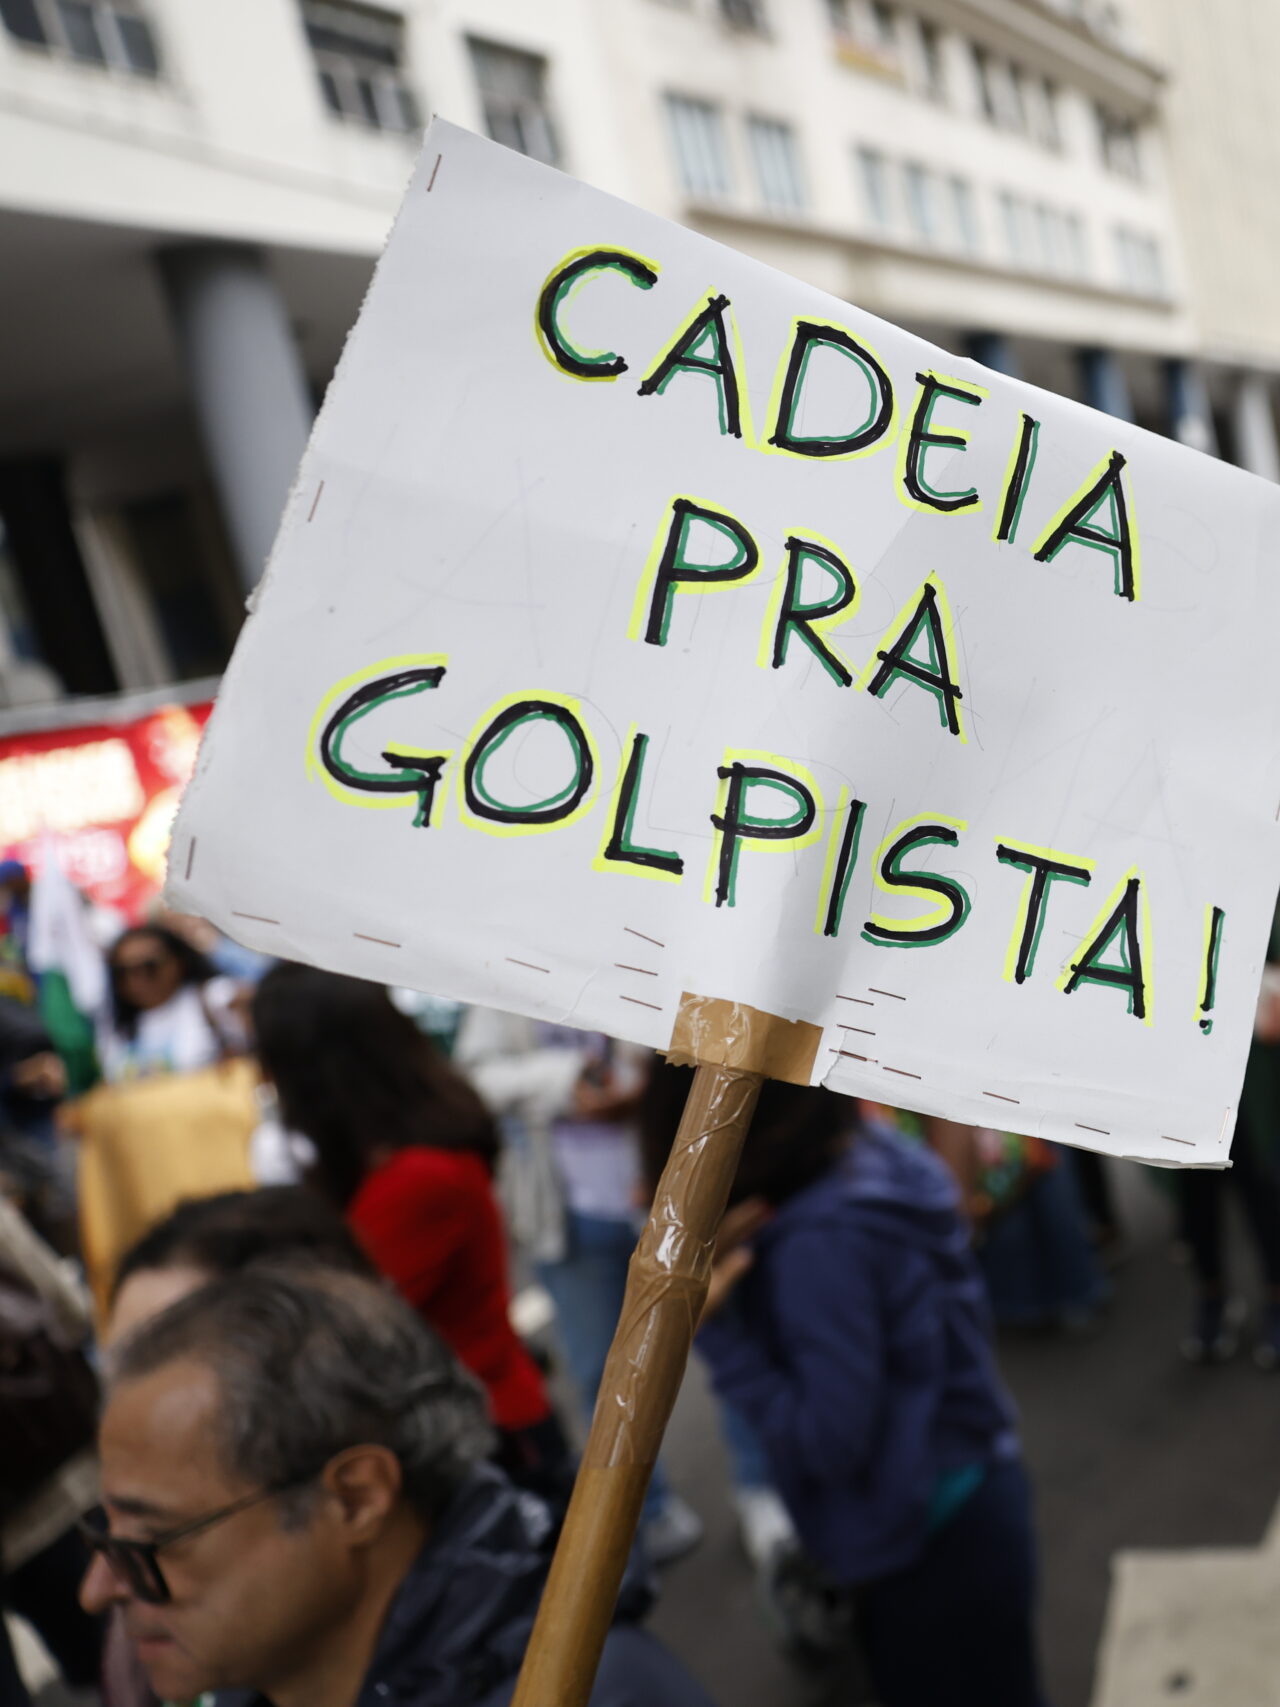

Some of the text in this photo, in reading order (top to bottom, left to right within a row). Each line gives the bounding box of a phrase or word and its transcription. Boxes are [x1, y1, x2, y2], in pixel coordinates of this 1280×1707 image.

[533, 244, 1140, 602] CADEIA
[627, 494, 968, 745] PRA
[305, 653, 1224, 1034] GOLPISTA!
